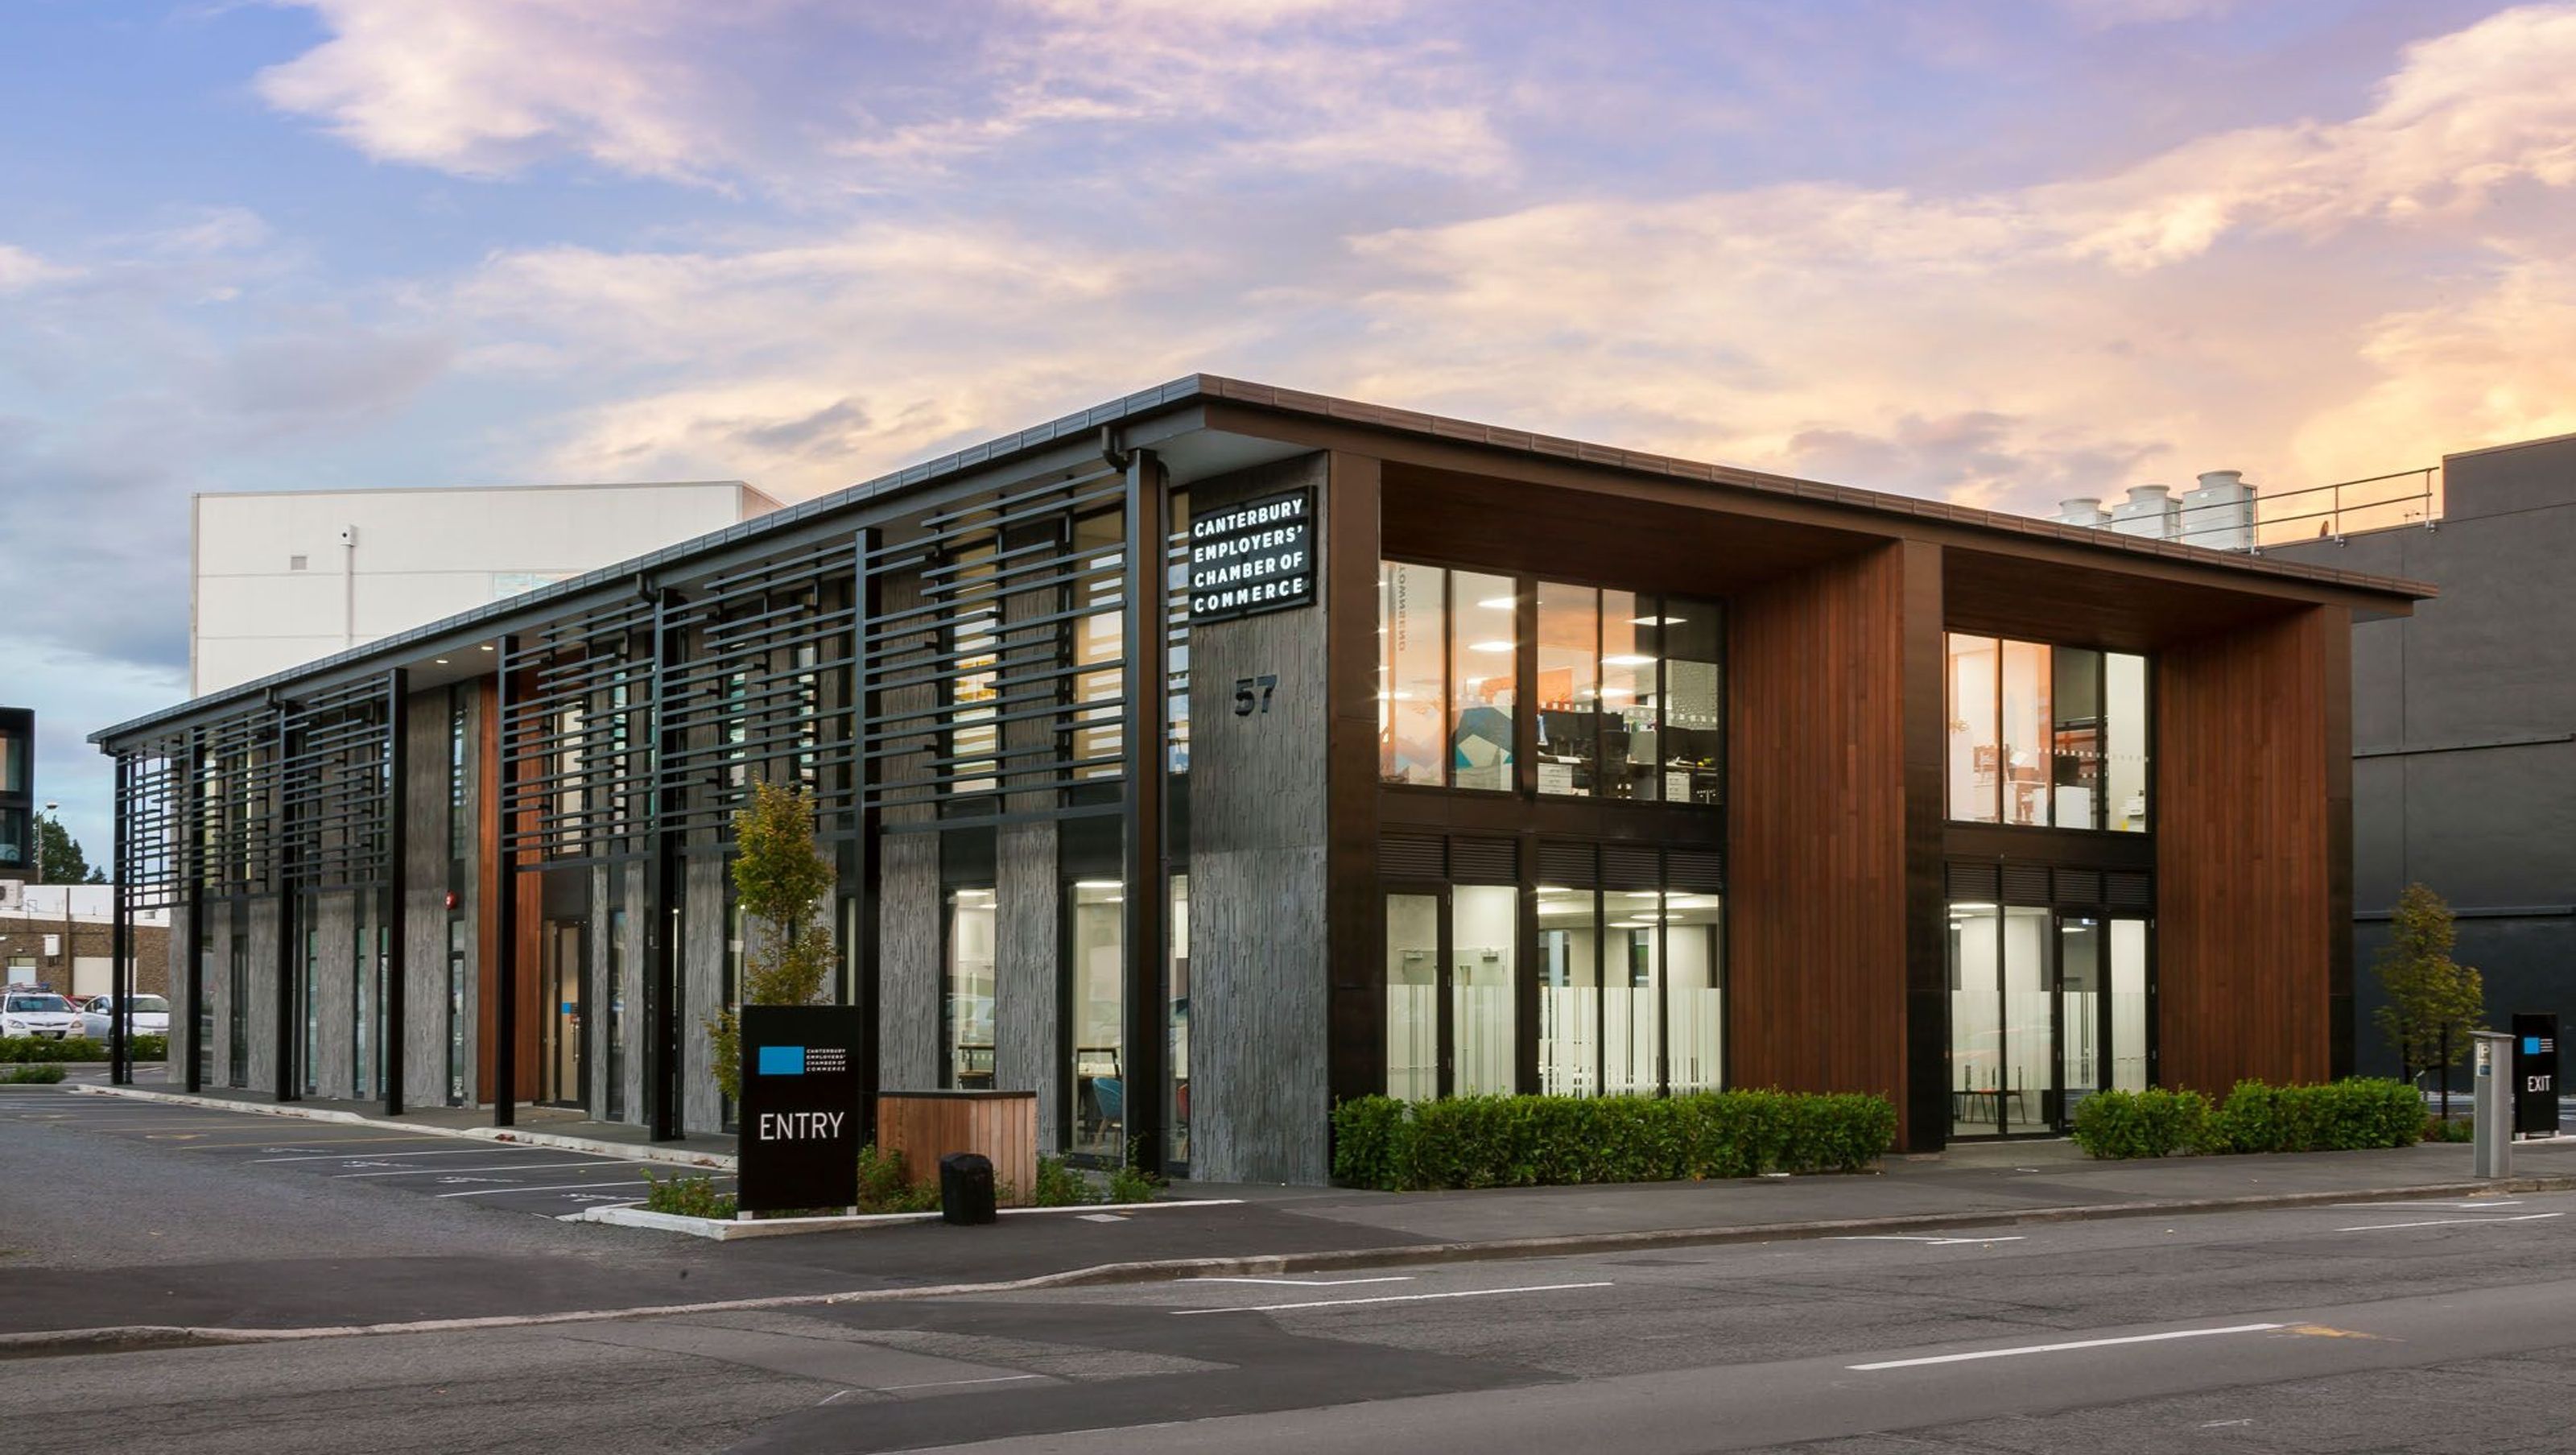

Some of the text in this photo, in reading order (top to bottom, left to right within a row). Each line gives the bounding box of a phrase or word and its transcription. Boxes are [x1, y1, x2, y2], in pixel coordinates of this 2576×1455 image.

[1195, 498, 1302, 538] CANTERBURY
[1195, 525, 1303, 563] EMPLOYERS'
[1195, 551, 1303, 588] CHAMBER OF
[1195, 578, 1302, 612] COMMERCE
[1235, 675, 1278, 717] 57
[2528, 1075, 2552, 1092] EXIT
[760, 1111, 844, 1140] ENTRY
